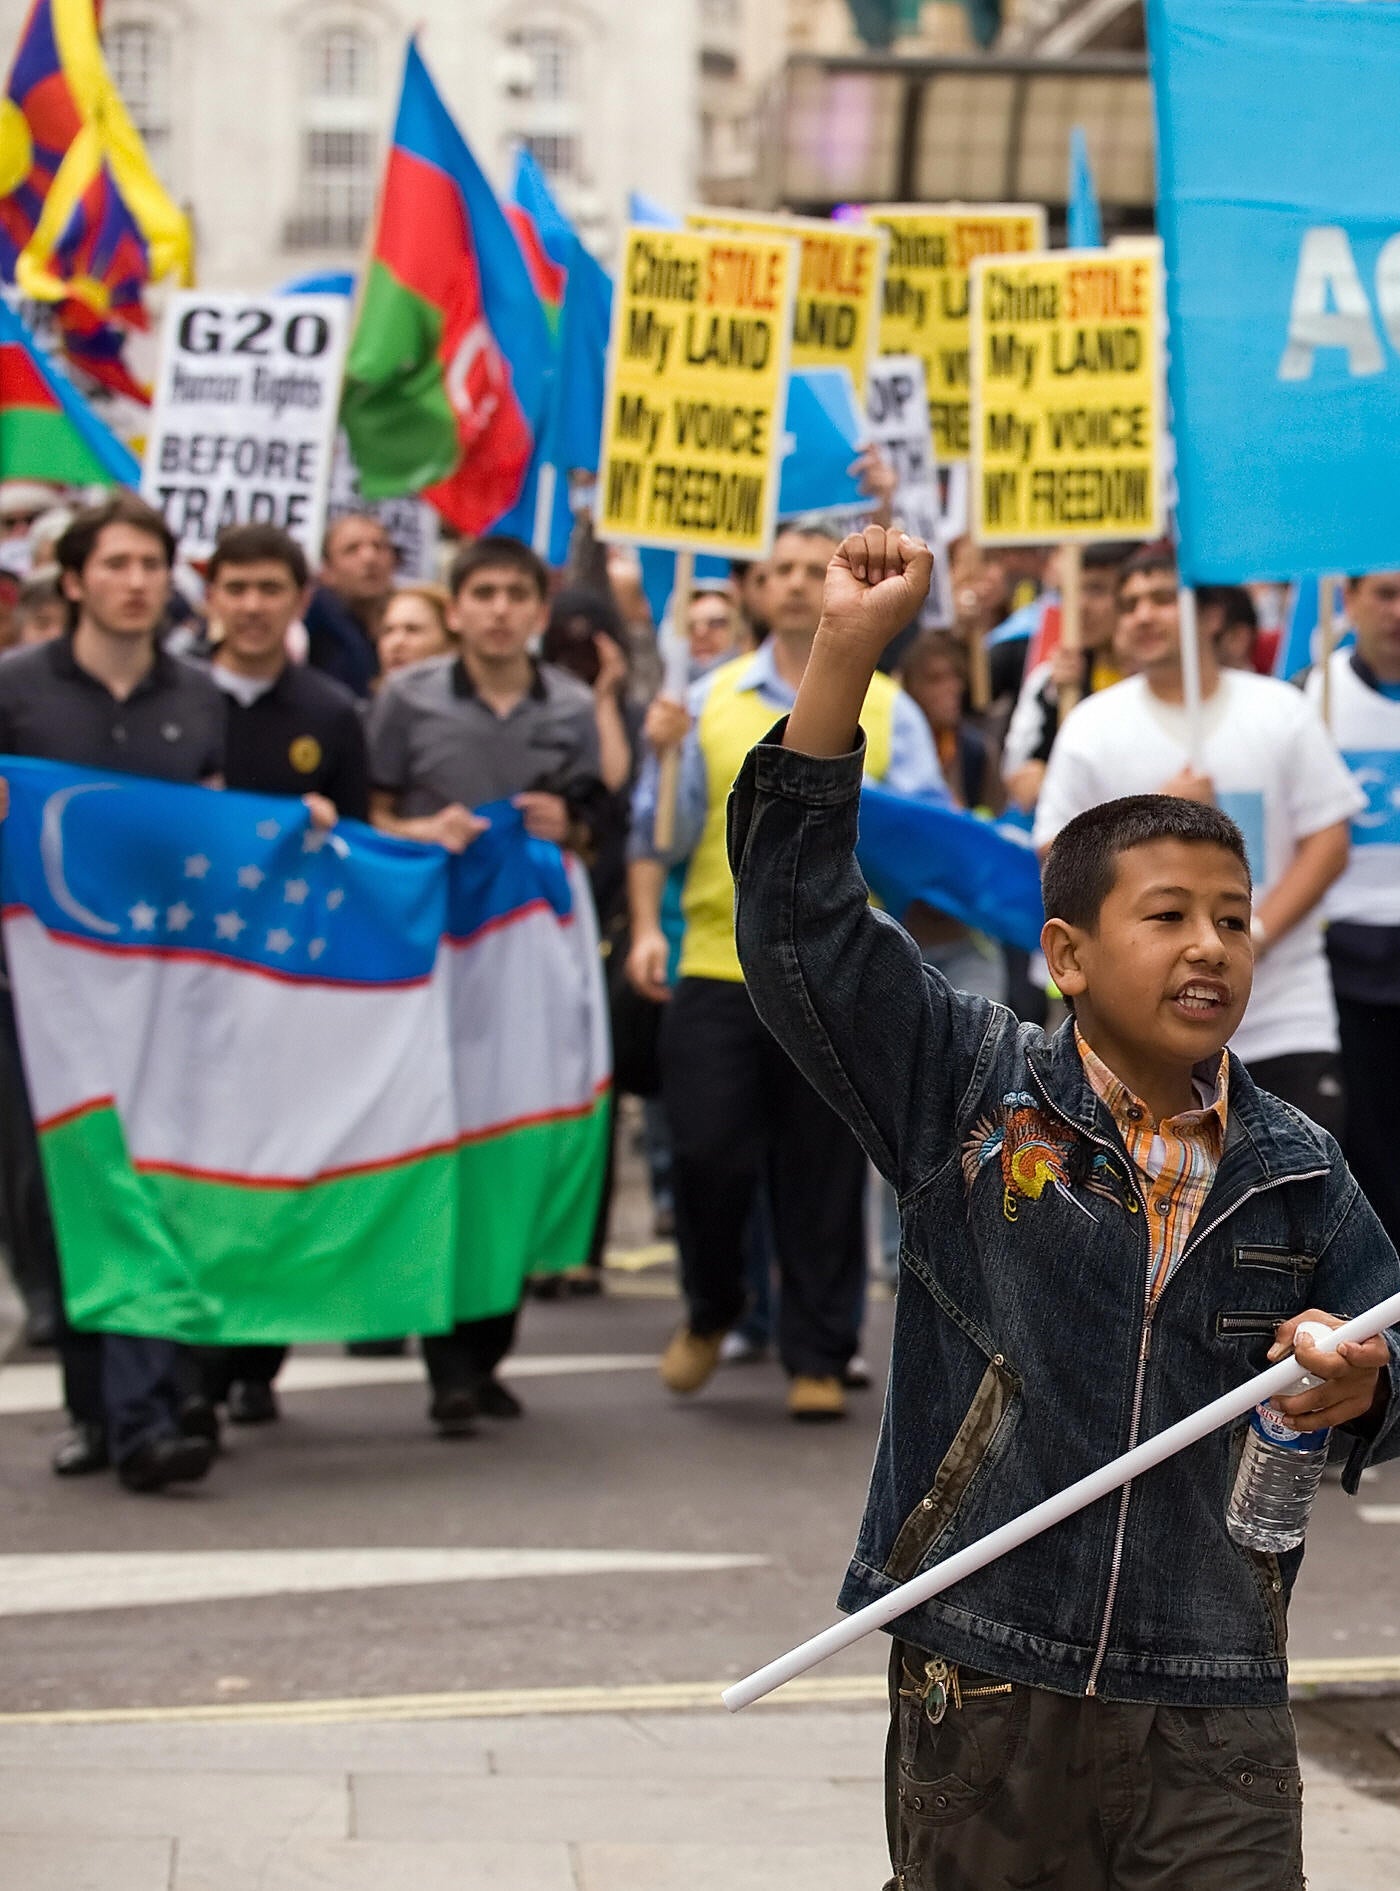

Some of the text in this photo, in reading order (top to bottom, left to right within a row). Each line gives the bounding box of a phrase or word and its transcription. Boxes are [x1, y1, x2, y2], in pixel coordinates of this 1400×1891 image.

[628, 240, 780, 311] China STOLE
[986, 270, 1058, 322] China
[1067, 265, 1148, 320] STOLE
[179, 308, 330, 358] G20
[626, 308, 771, 375] My LAND
[988, 332, 1038, 389] My
[1053, 329, 1142, 375] LAND
[616, 395, 767, 456] My VOICE
[988, 412, 1037, 462] My
[1049, 406, 1147, 450] VOICE
[159, 433, 318, 482] BEFORE
[649, 464, 765, 535] FREEDOM
[1029, 467, 1149, 525] FREEDOM
